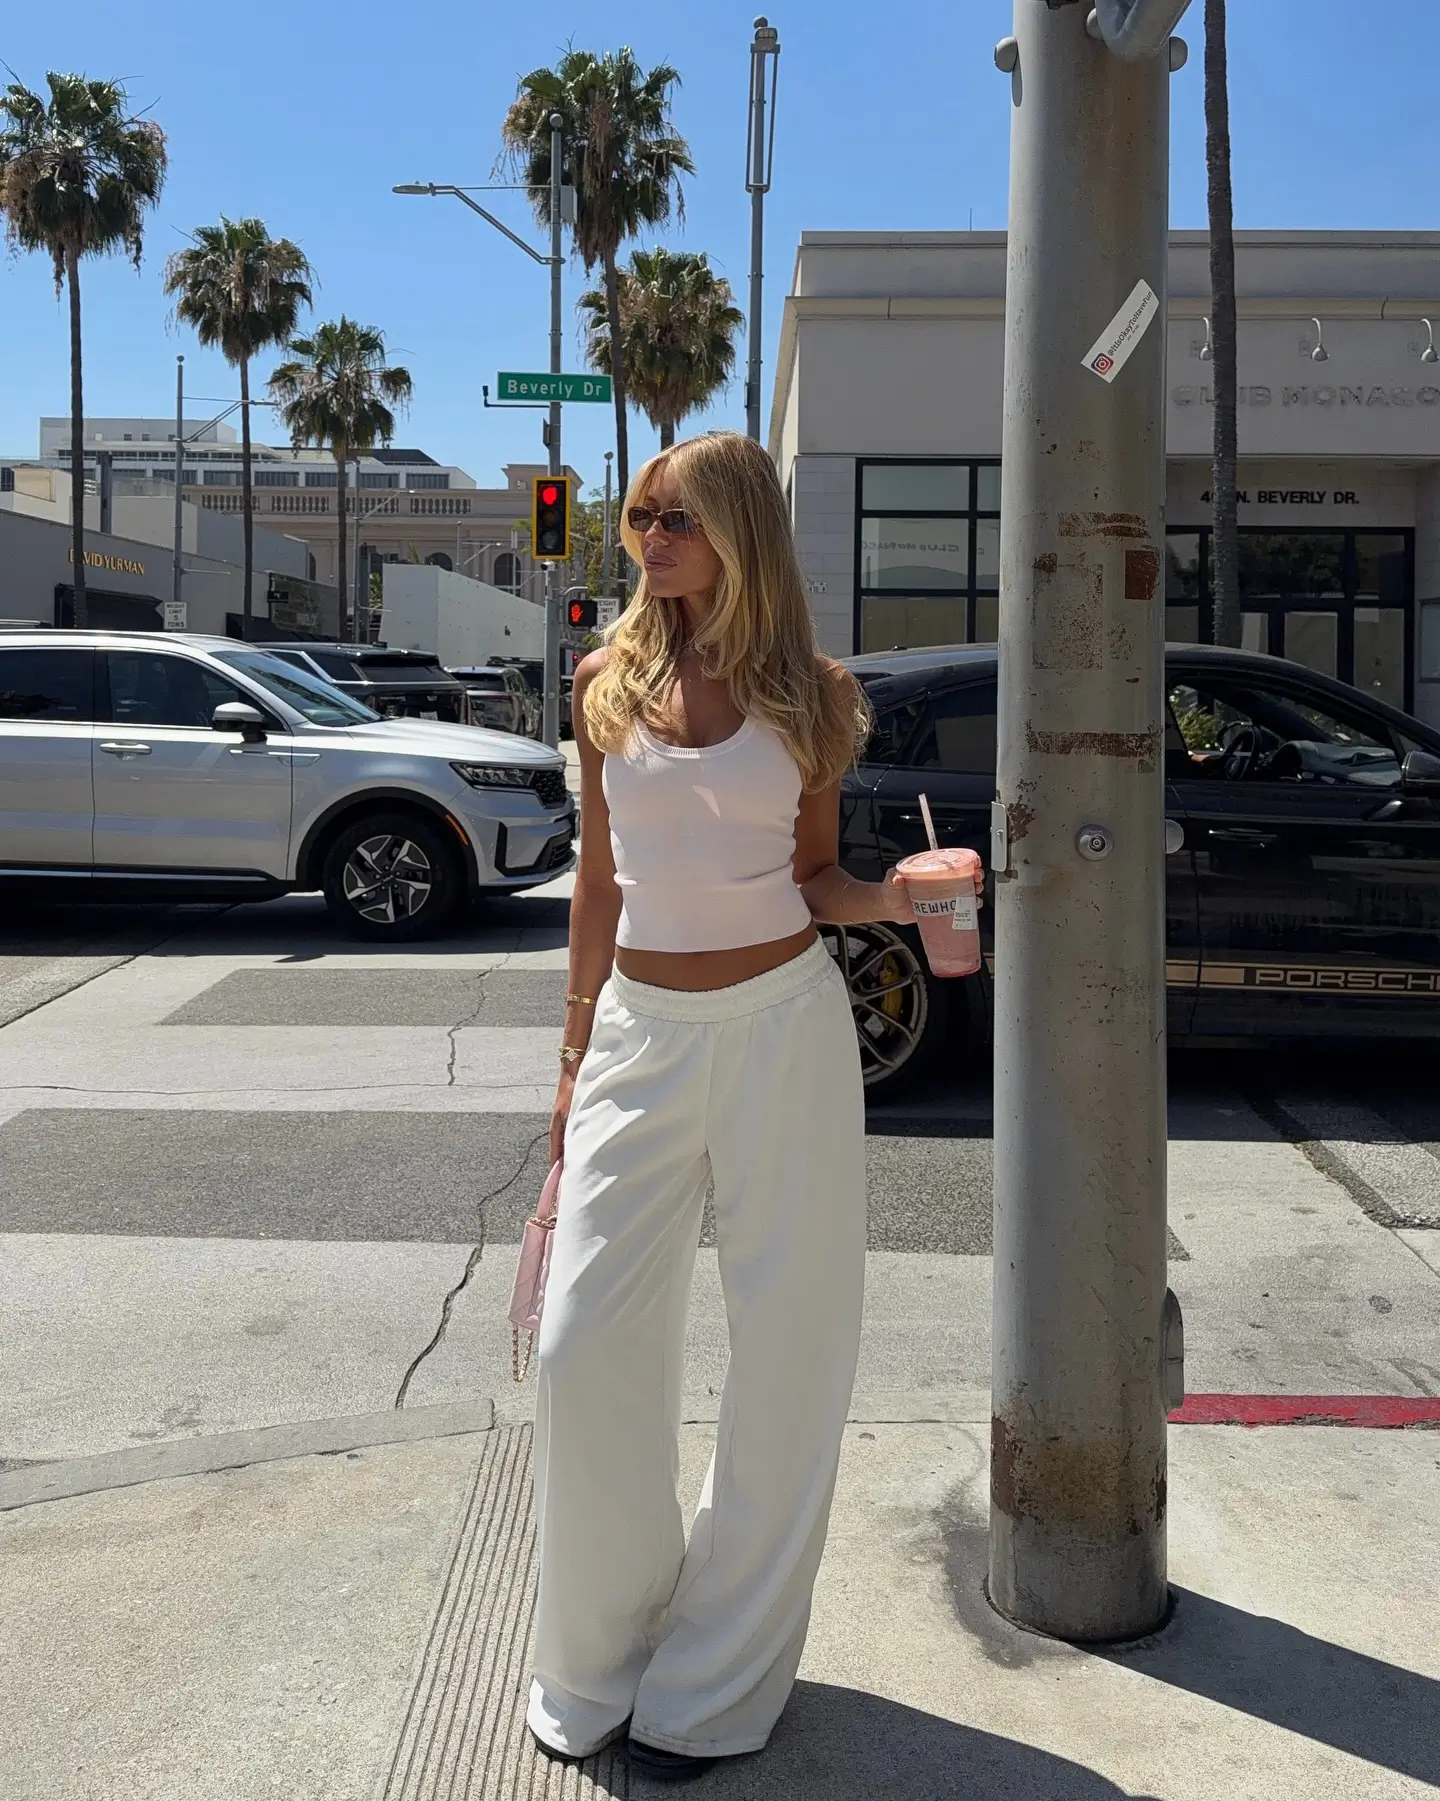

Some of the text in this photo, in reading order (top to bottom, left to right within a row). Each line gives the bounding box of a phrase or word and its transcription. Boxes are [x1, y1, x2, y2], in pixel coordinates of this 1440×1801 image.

[1107, 291, 1153, 356] @ItIsOkayToHaveFun
[508, 379, 603, 399] Beverly Dr
[1281, 385, 1440, 407] MONACO
[1257, 491, 1326, 504] BEVERLY
[1334, 491, 1360, 504] DR.
[69, 548, 144, 575] DVID YURMAN
[913, 900, 957, 914] REWHO
[1256, 969, 1440, 990] PORSCH
